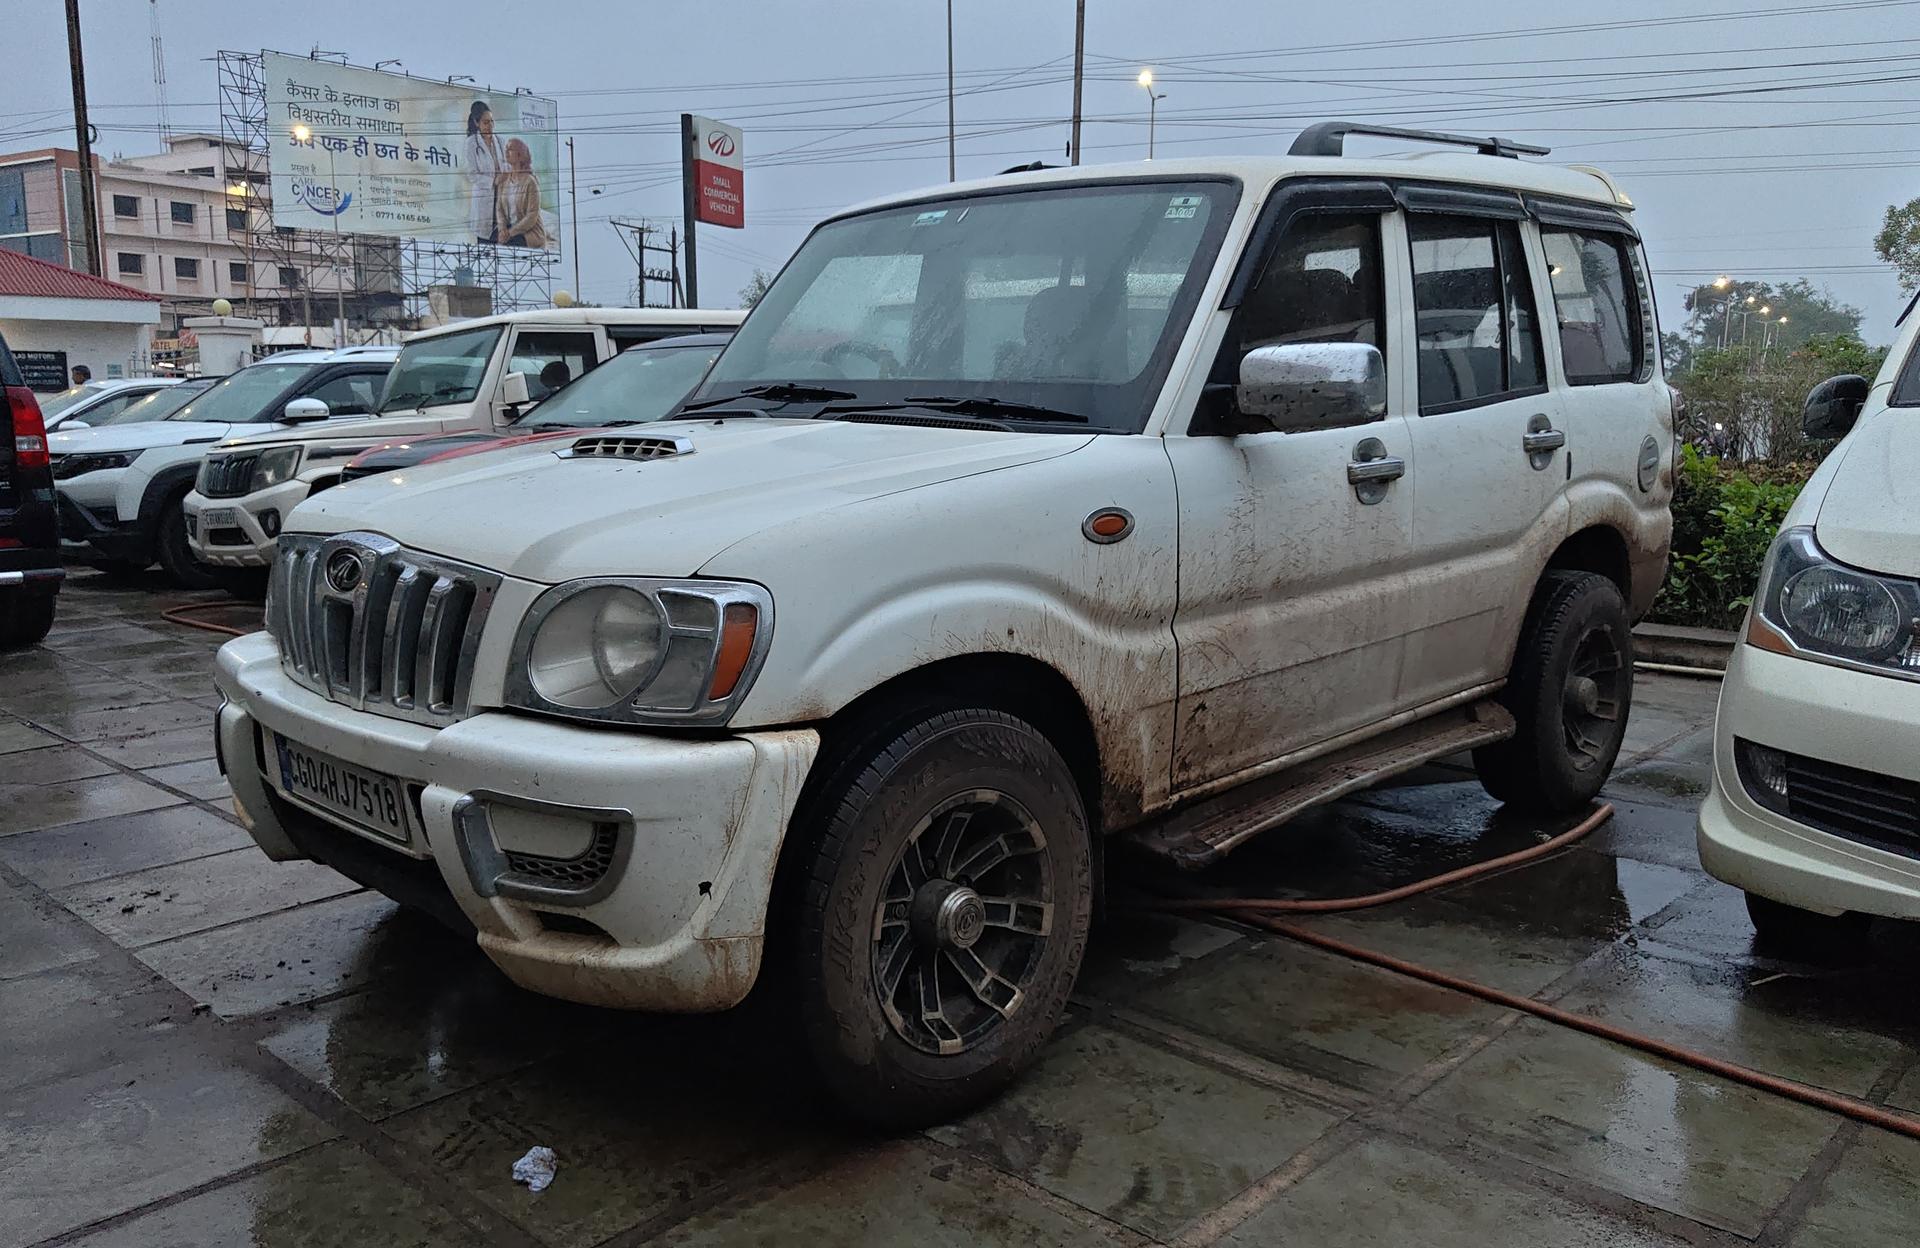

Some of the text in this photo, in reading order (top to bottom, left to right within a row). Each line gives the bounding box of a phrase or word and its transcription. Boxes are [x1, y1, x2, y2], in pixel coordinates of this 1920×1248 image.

[286, 78, 400, 113] कैंसर के इलाज का
[287, 102, 351, 128] विश्वस्तरीय
[320, 135, 349, 153] एक
[353, 135, 369, 158] ही
[373, 142, 399, 161] छत
[404, 141, 419, 162] के
[713, 176, 731, 189] SMALL
[704, 186, 740, 203] COMMERCIAL
[709, 201, 736, 215] VEHICLES
